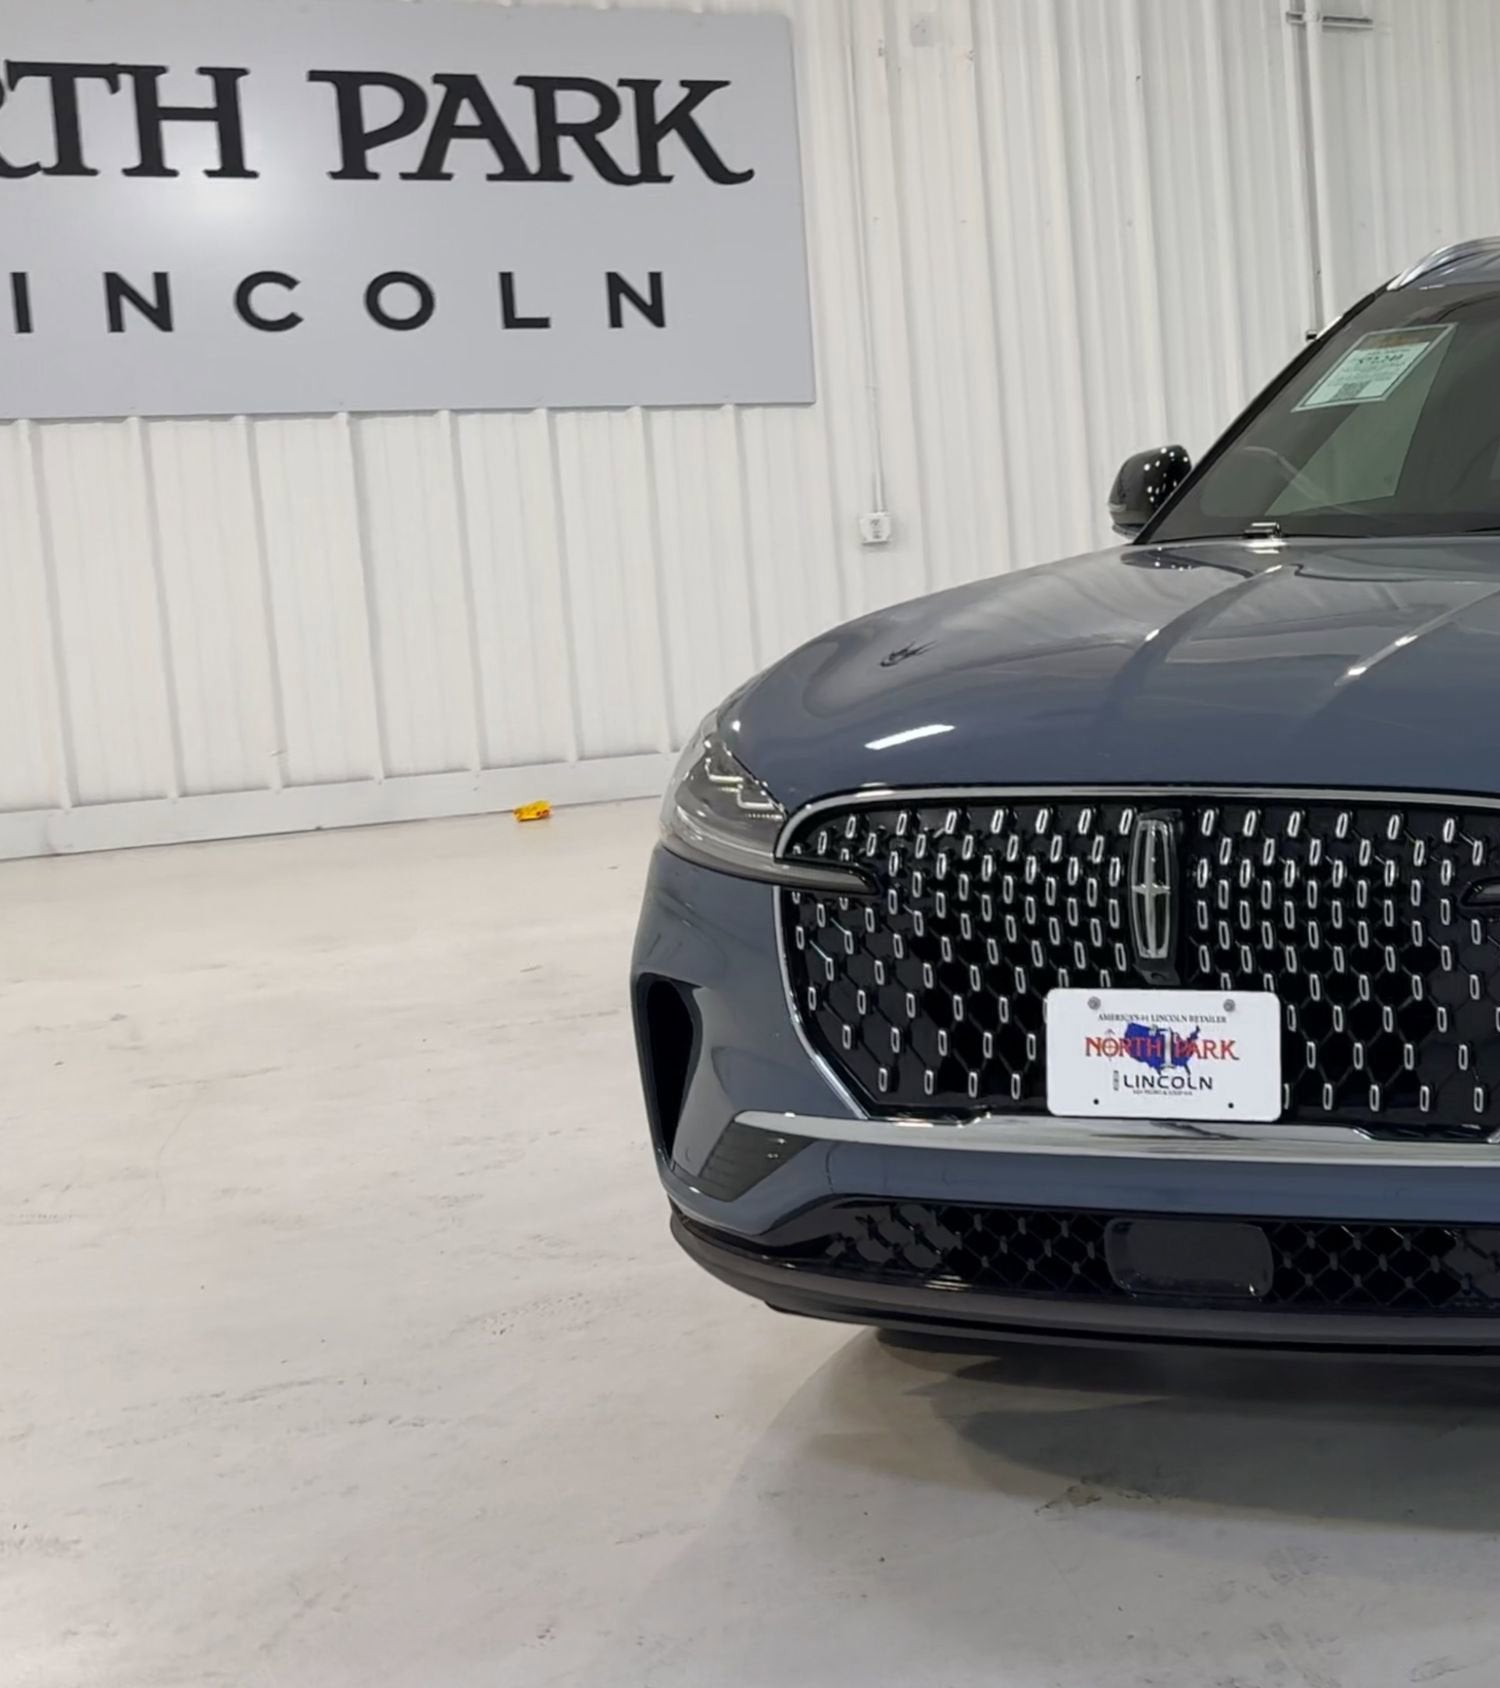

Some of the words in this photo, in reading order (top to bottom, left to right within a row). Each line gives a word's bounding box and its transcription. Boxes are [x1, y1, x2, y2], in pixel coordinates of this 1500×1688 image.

[307, 69, 755, 187] PARK
[1151, 1014, 1187, 1023] LINCOLN
[1189, 1015, 1227, 1024] RETAILER
[1085, 1036, 1161, 1059] NORTH
[1175, 1038, 1240, 1061] PARK
[1123, 1074, 1213, 1090] LINCOLN
